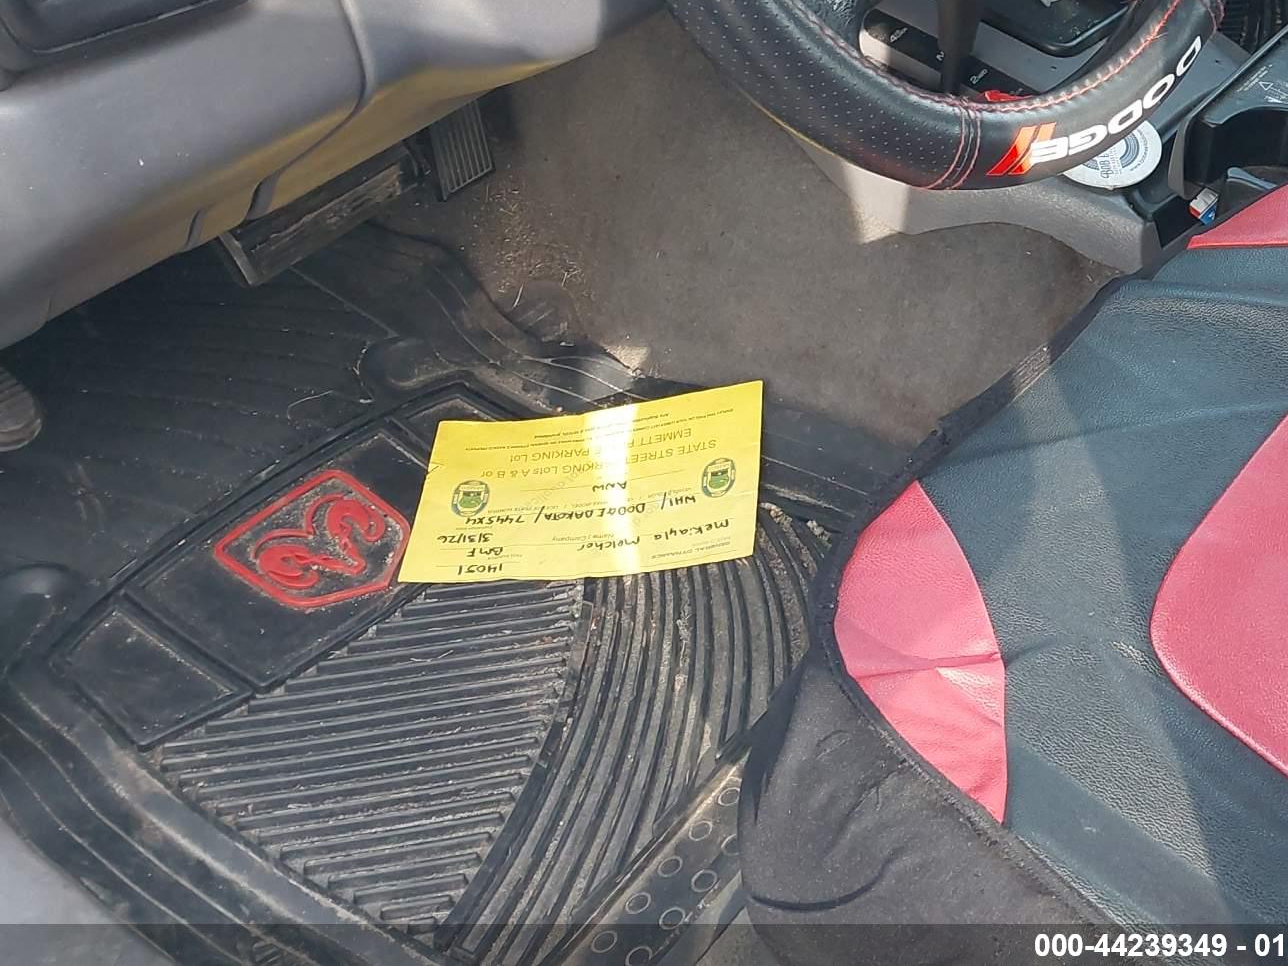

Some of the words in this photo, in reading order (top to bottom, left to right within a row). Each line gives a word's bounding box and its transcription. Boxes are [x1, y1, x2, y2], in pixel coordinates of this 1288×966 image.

[1030, 35, 1202, 165] DODGE
[639, 427, 692, 446] EMMETT
[678, 439, 717, 455] STATE
[509, 454, 528, 463] Lot
[532, 449, 590, 462] PARKING
[497, 470, 505, 478] B
[522, 468, 531, 477] A
[562, 461, 604, 474] RKING
